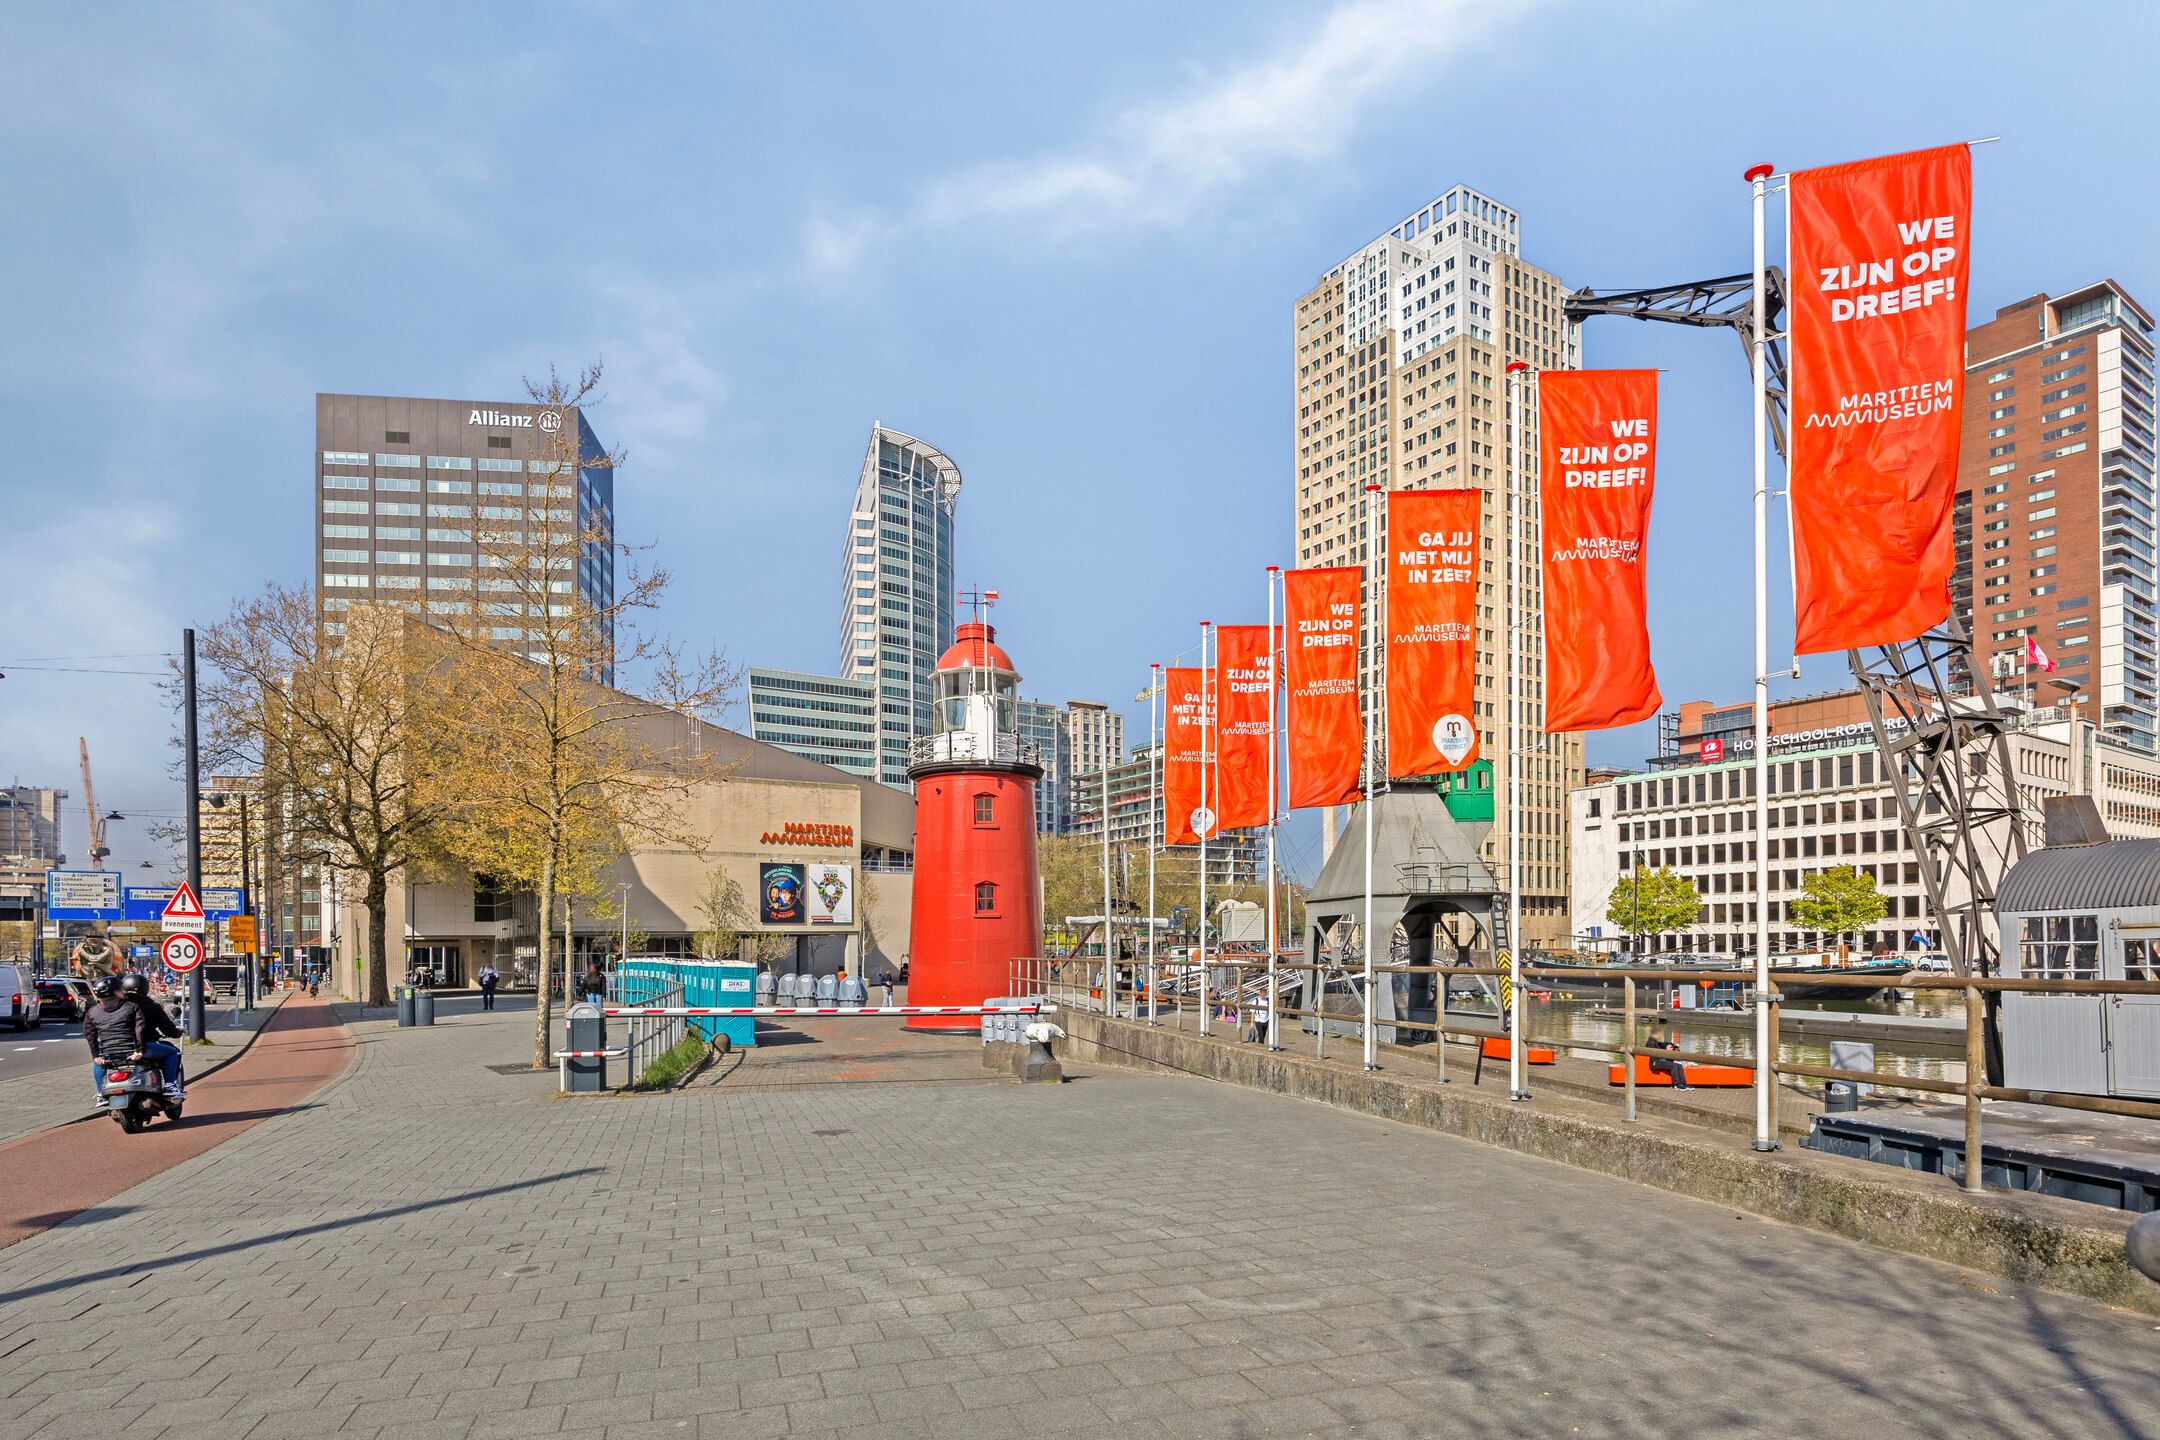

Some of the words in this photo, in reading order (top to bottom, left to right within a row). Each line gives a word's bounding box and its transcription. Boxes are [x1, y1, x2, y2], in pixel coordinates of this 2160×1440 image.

[1898, 215, 1955, 245] WE
[1820, 258, 1894, 292] ZIJN
[1902, 247, 1956, 277] OP
[1832, 277, 1956, 323] DREEF!
[1840, 378, 1953, 411] MARITIEM
[468, 409, 533, 428] Allianz
[1804, 395, 1953, 429] MUSEUM
[1611, 419, 1648, 438] WE
[1560, 446, 1608, 465] ZIJN
[1613, 443, 1648, 463] OP
[1565, 467, 1646, 489] DREEF!
[1418, 532, 1445, 547] GA
[1448, 531, 1473, 546] JIJ
[1399, 550, 1437, 565] MET
[1441, 550, 1472, 565] MIJ
[1408, 569, 1428, 584] IN
[1431, 568, 1472, 584] ZEE?
[1330, 604, 1353, 616] WE
[1298, 619, 1329, 632] ZIJN
[1332, 618, 1353, 631] OP
[1414, 623, 1470, 633] MARITIEM
[1302, 633, 1353, 647] DREEF!
[1394, 632, 1470, 643] MUSEUM
[1255, 656, 1270, 667] W
[1227, 669, 1254, 680] ZIJN
[1231, 682, 1270, 693] DREEF
[1309, 679, 1356, 688] MARITIEM
[1184, 692, 1200, 702] GA
[1293, 687, 1356, 697] MUSEUM
[1173, 704, 1195, 714] MET
[1178, 716, 1190, 725] IN
[1733, 727, 1833, 752] HOESCHOOL
[785, 822, 853, 836] MARITIEM
[760, 832, 853, 848] MUSEUM
[165, 921, 202, 929] evenement
[169, 944, 197, 959] 30
